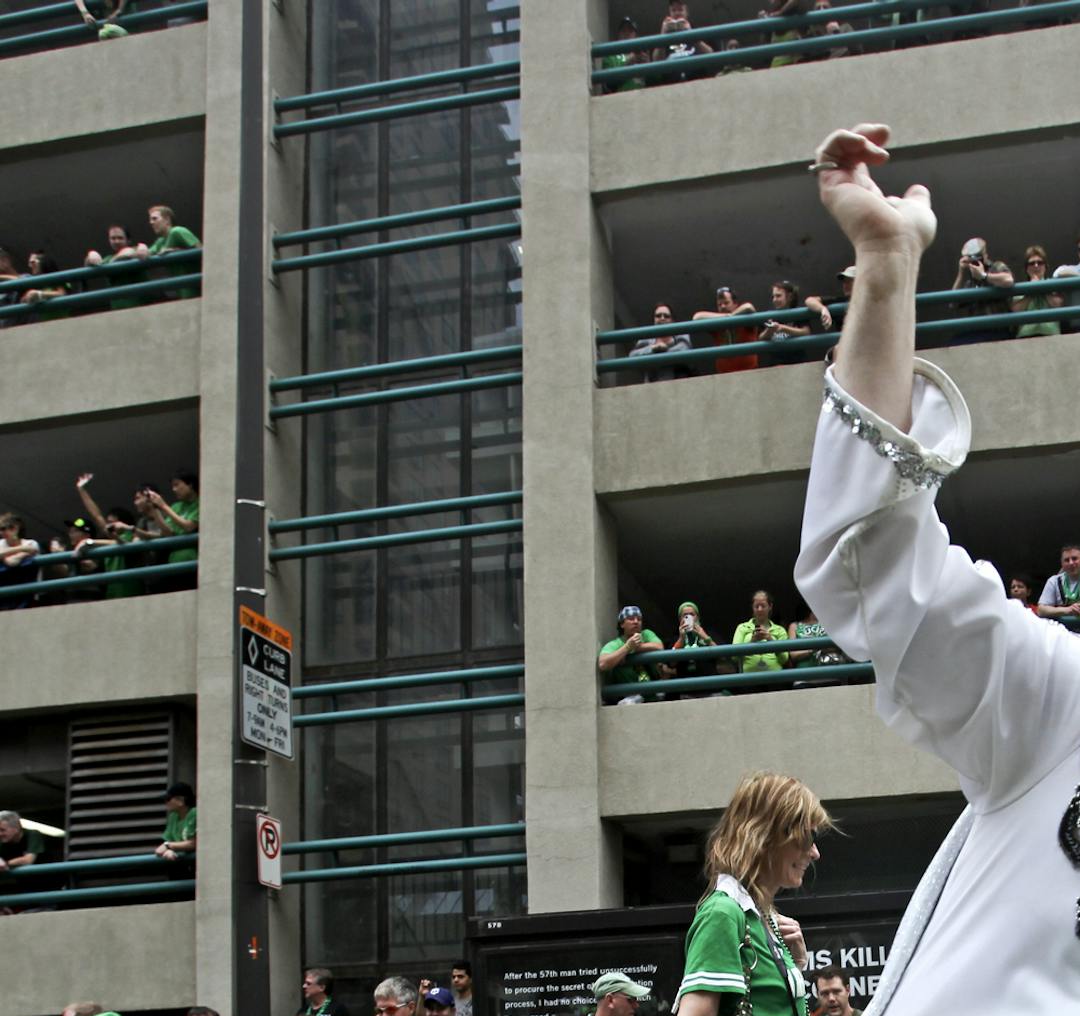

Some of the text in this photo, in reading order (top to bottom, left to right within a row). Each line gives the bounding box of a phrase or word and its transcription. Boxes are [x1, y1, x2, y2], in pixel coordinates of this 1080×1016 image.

[263, 644, 286, 665] CURB
[264, 660, 286, 680] LANE
[247, 670, 287, 700] BUSES AND
[245, 682, 288, 713] RIGHT TURNS
[257, 702, 277, 720] ONLY
[250, 725, 266, 742] MON
[273, 736, 286, 751] FRI
[504, 971, 523, 981] After
[524, 971, 538, 980] the
[539, 970, 558, 979] 57th
[560, 969, 577, 977] man
[579, 967, 598, 976] tried
[504, 987, 513, 995] to
[514, 985, 545, 996] procure
[546, 984, 560, 992] the
[560, 982, 585, 992] secret
[504, 1000, 537, 1011] process,
[543, 998, 559, 1007] had
[560, 998, 570, 1006] no
